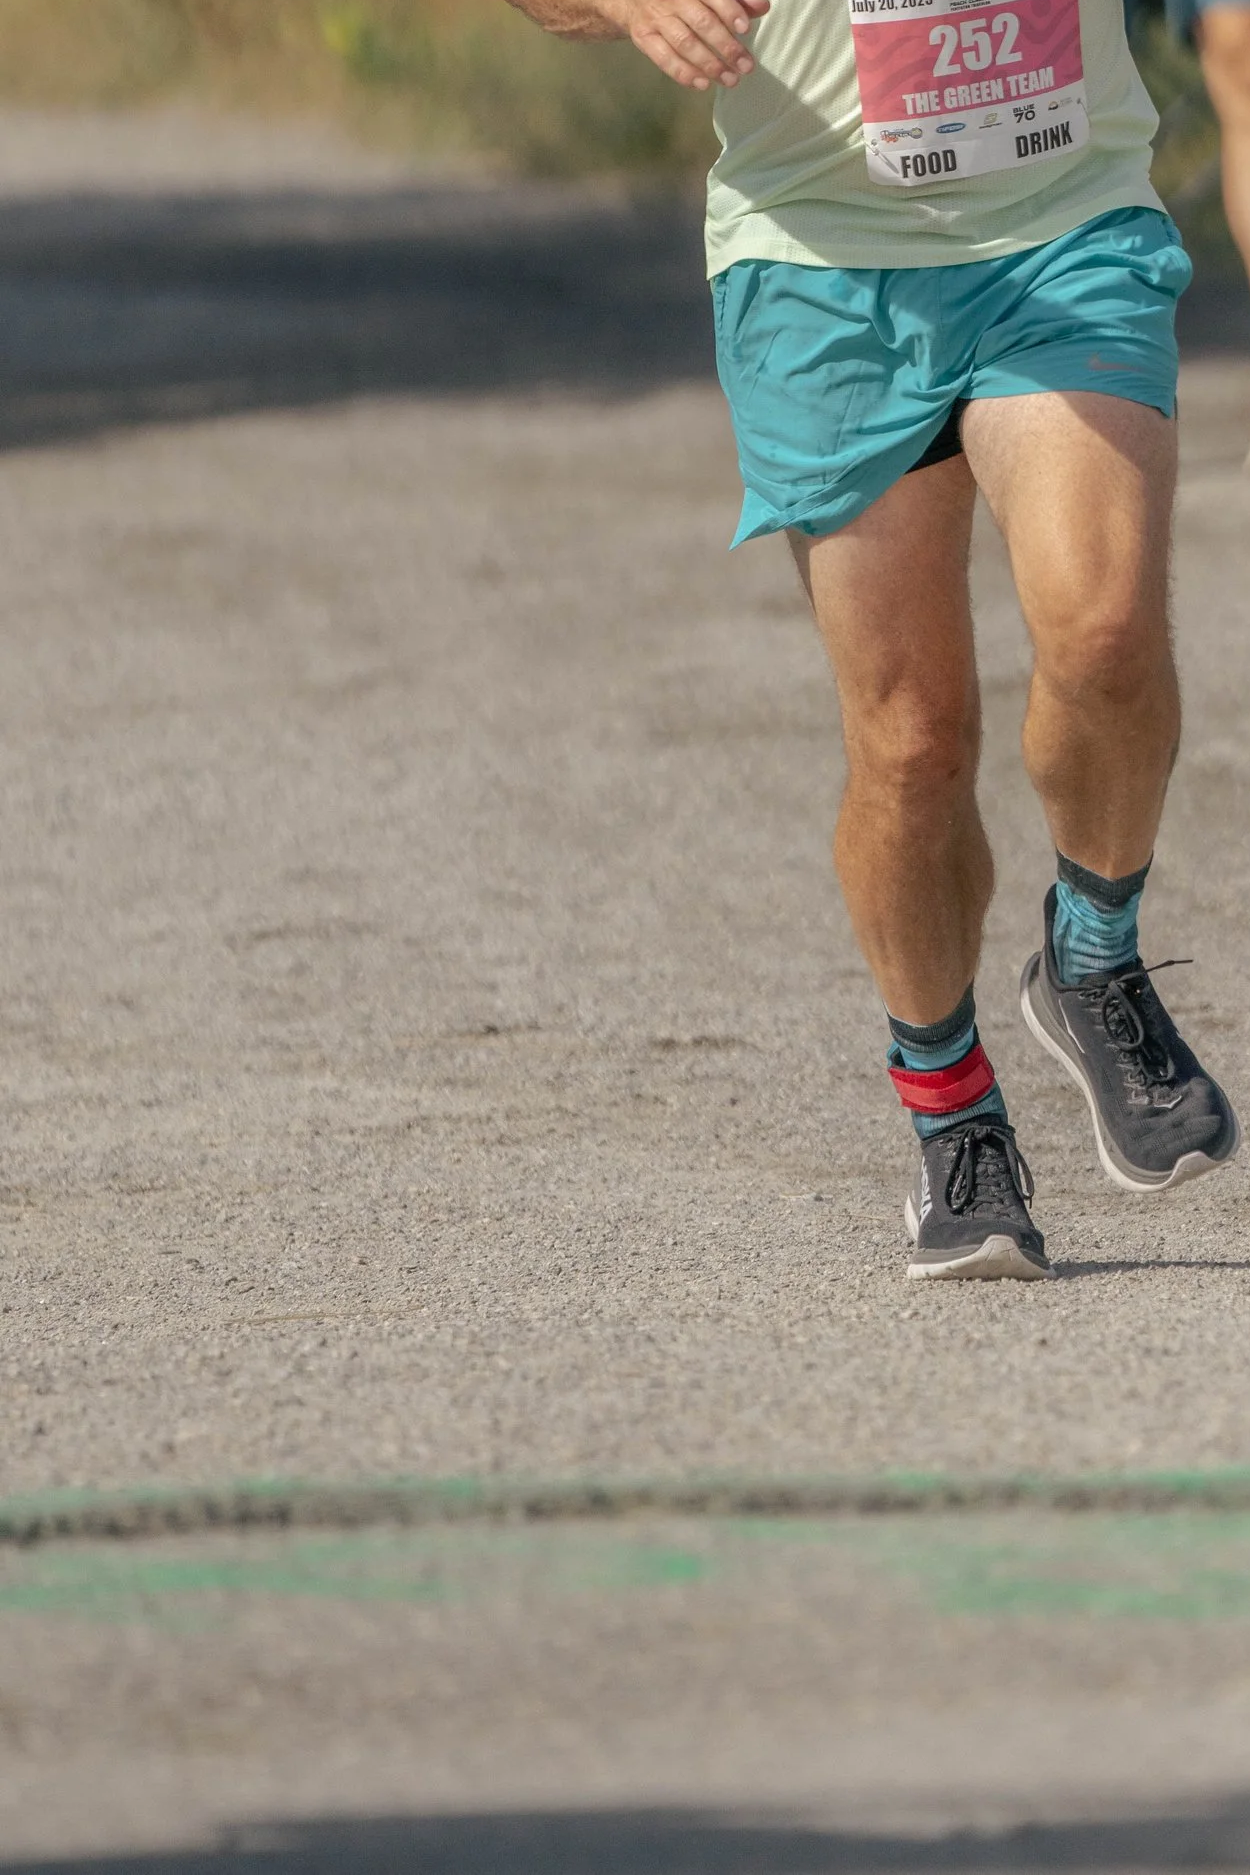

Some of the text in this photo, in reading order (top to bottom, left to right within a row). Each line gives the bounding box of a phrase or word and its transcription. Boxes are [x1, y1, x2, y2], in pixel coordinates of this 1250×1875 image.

[929, 13, 1022, 78] 252
[902, 66, 1054, 116] THE GREEN TEAM
[1013, 104, 1035, 114] BLUE
[1014, 110, 1035, 123] 70
[1015, 121, 1073, 159] DRINK
[900, 149, 957, 179] FOOD
